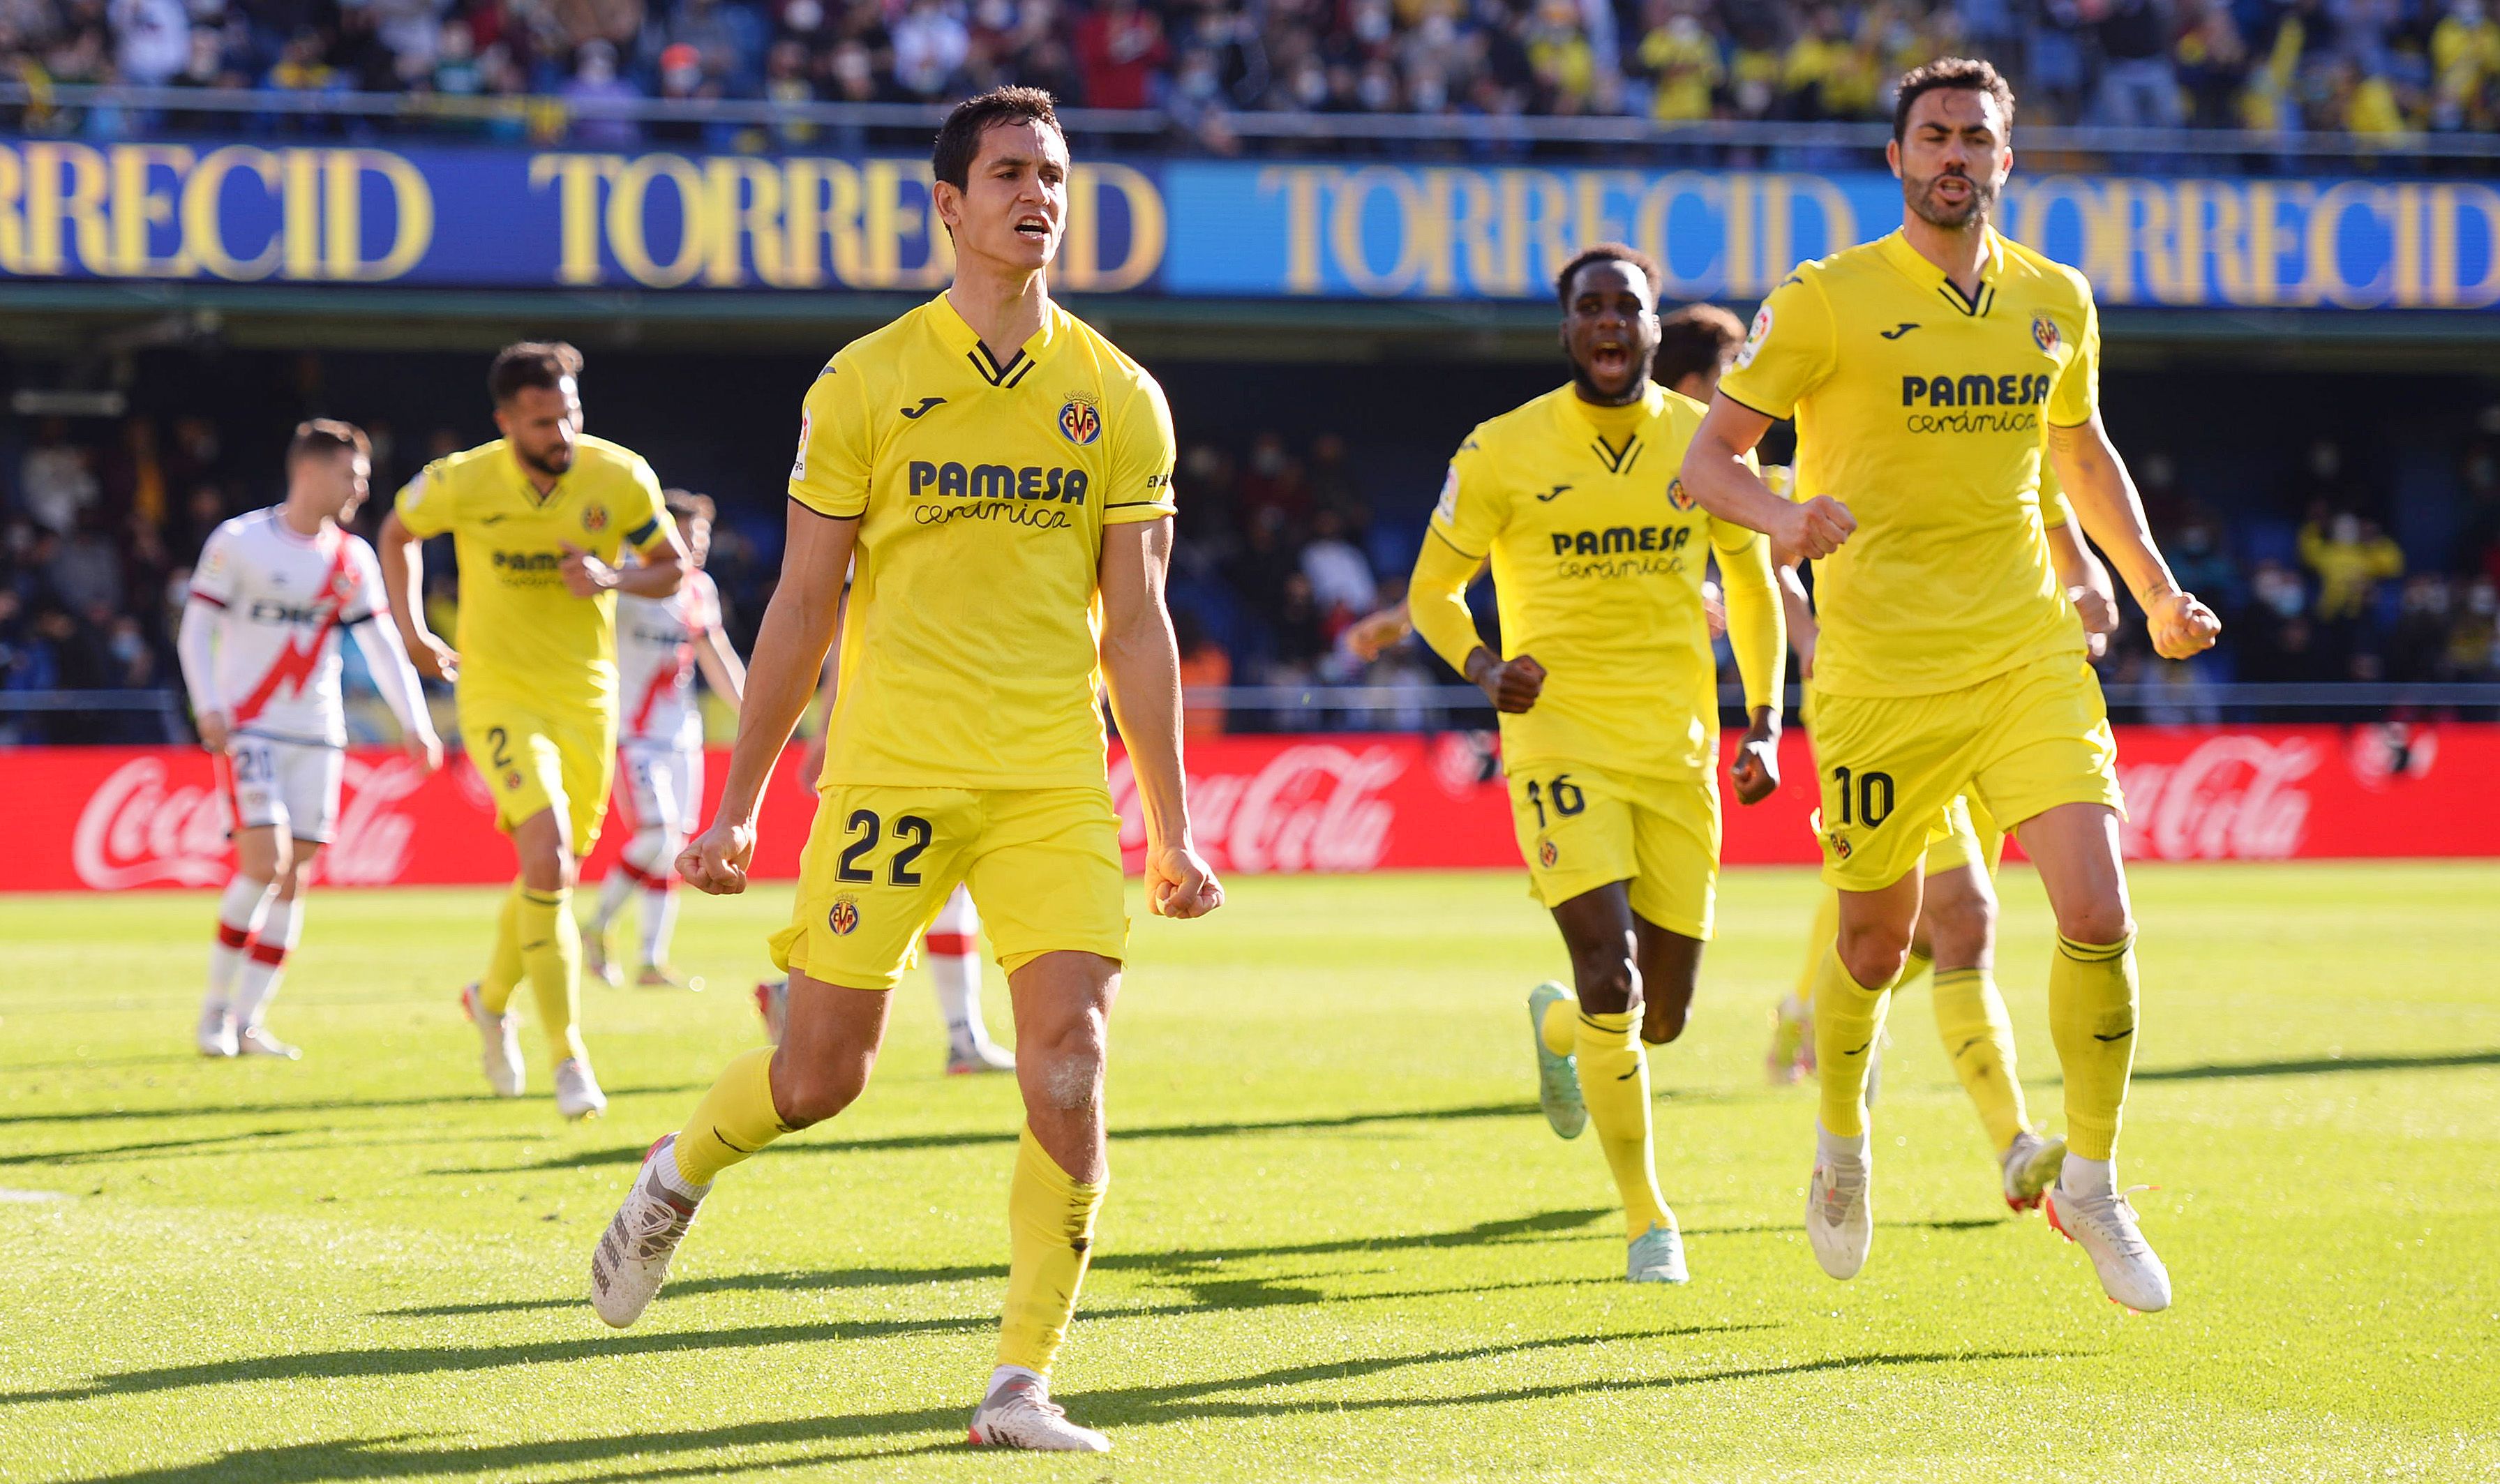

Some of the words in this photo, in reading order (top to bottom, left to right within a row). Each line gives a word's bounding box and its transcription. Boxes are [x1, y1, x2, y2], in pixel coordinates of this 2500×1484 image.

[528, 152, 1166, 290] TORRED
[1259, 165, 1858, 301] TORRECID
[1902, 374, 2050, 407] PAMESA
[908, 460, 1088, 506] PAMESA
[1551, 526, 1691, 556] PAMESA
[488, 726, 511, 767] 2
[1527, 774, 1585, 828] 16
[1833, 765, 1894, 830] 10
[834, 809, 933, 887] 22
